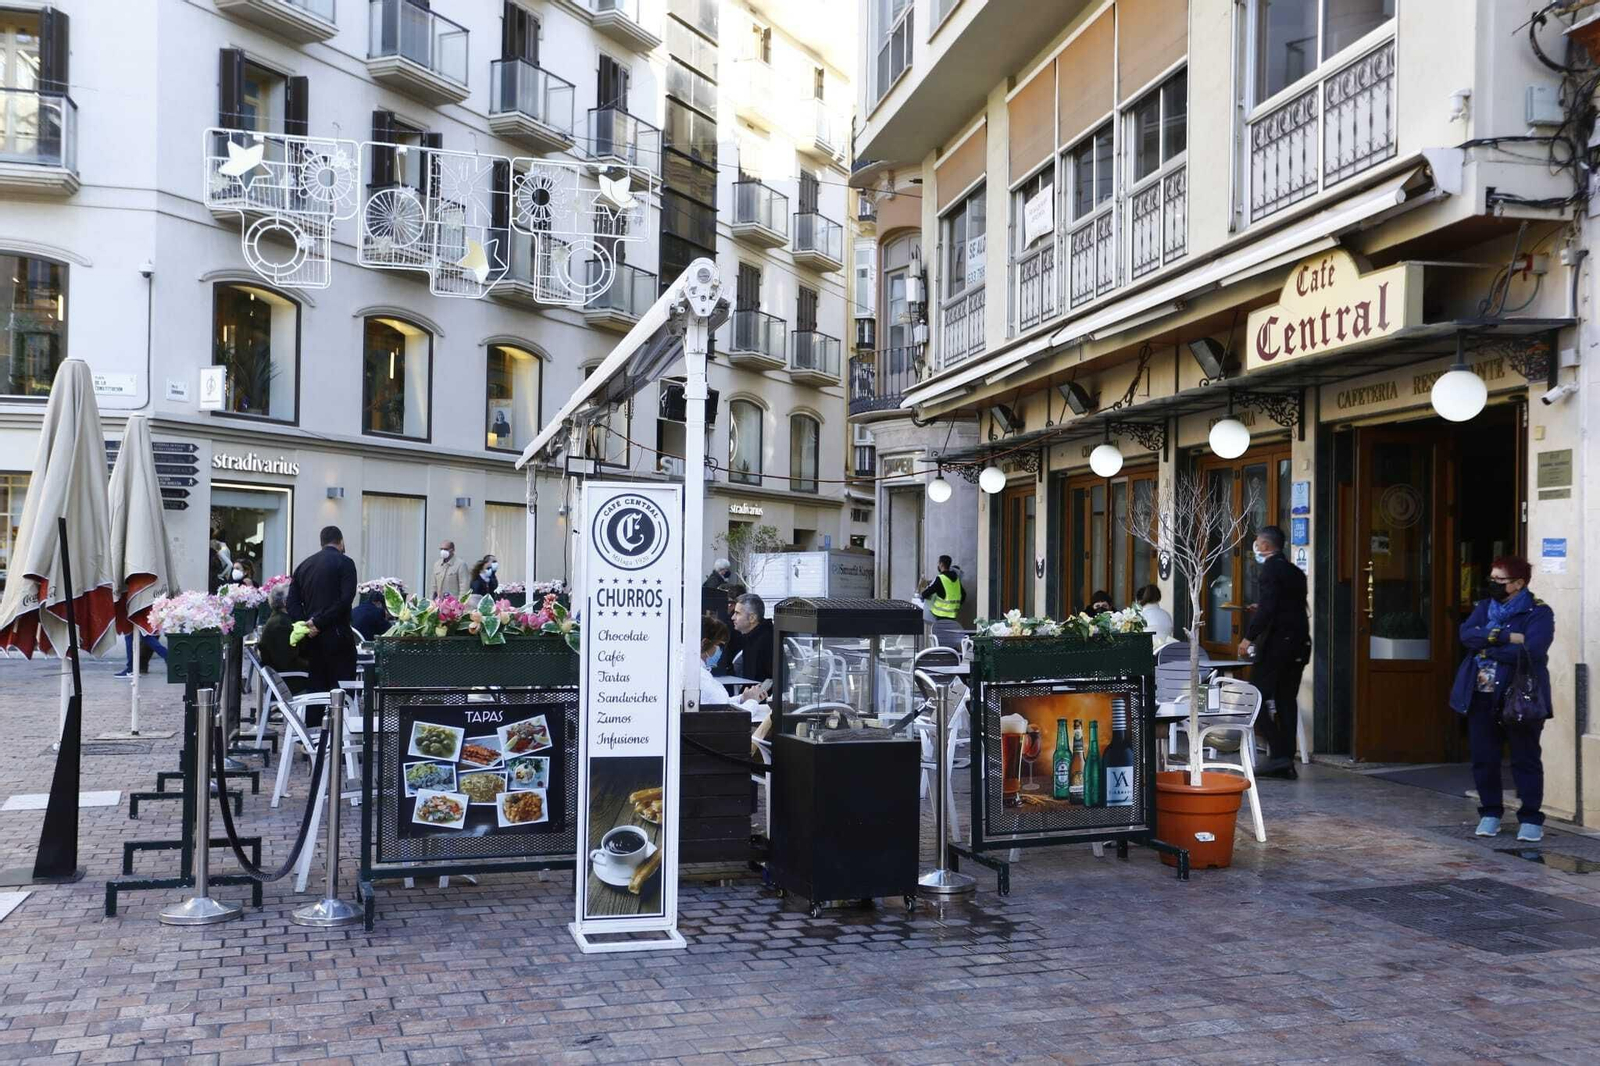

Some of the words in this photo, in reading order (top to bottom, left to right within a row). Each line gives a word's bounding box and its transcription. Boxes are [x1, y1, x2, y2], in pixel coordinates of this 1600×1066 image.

[1296, 255, 1336, 297] Café
[1256, 281, 1391, 361] Central
[1337, 381, 1398, 409] CAFETERIA
[211, 452, 300, 476] stradivarius
[624, 499, 659, 519] CENTRAL
[596, 588, 663, 608] CHURROS
[598, 630, 649, 641] Chocolate
[597, 650, 625, 667] Cafés
[598, 671, 630, 682] Tartas
[597, 691, 658, 703] Sandwiches
[464, 710, 504, 723] TAPAS
[597, 712, 632, 724] Zumos
[596, 732, 650, 750] Infusiones
